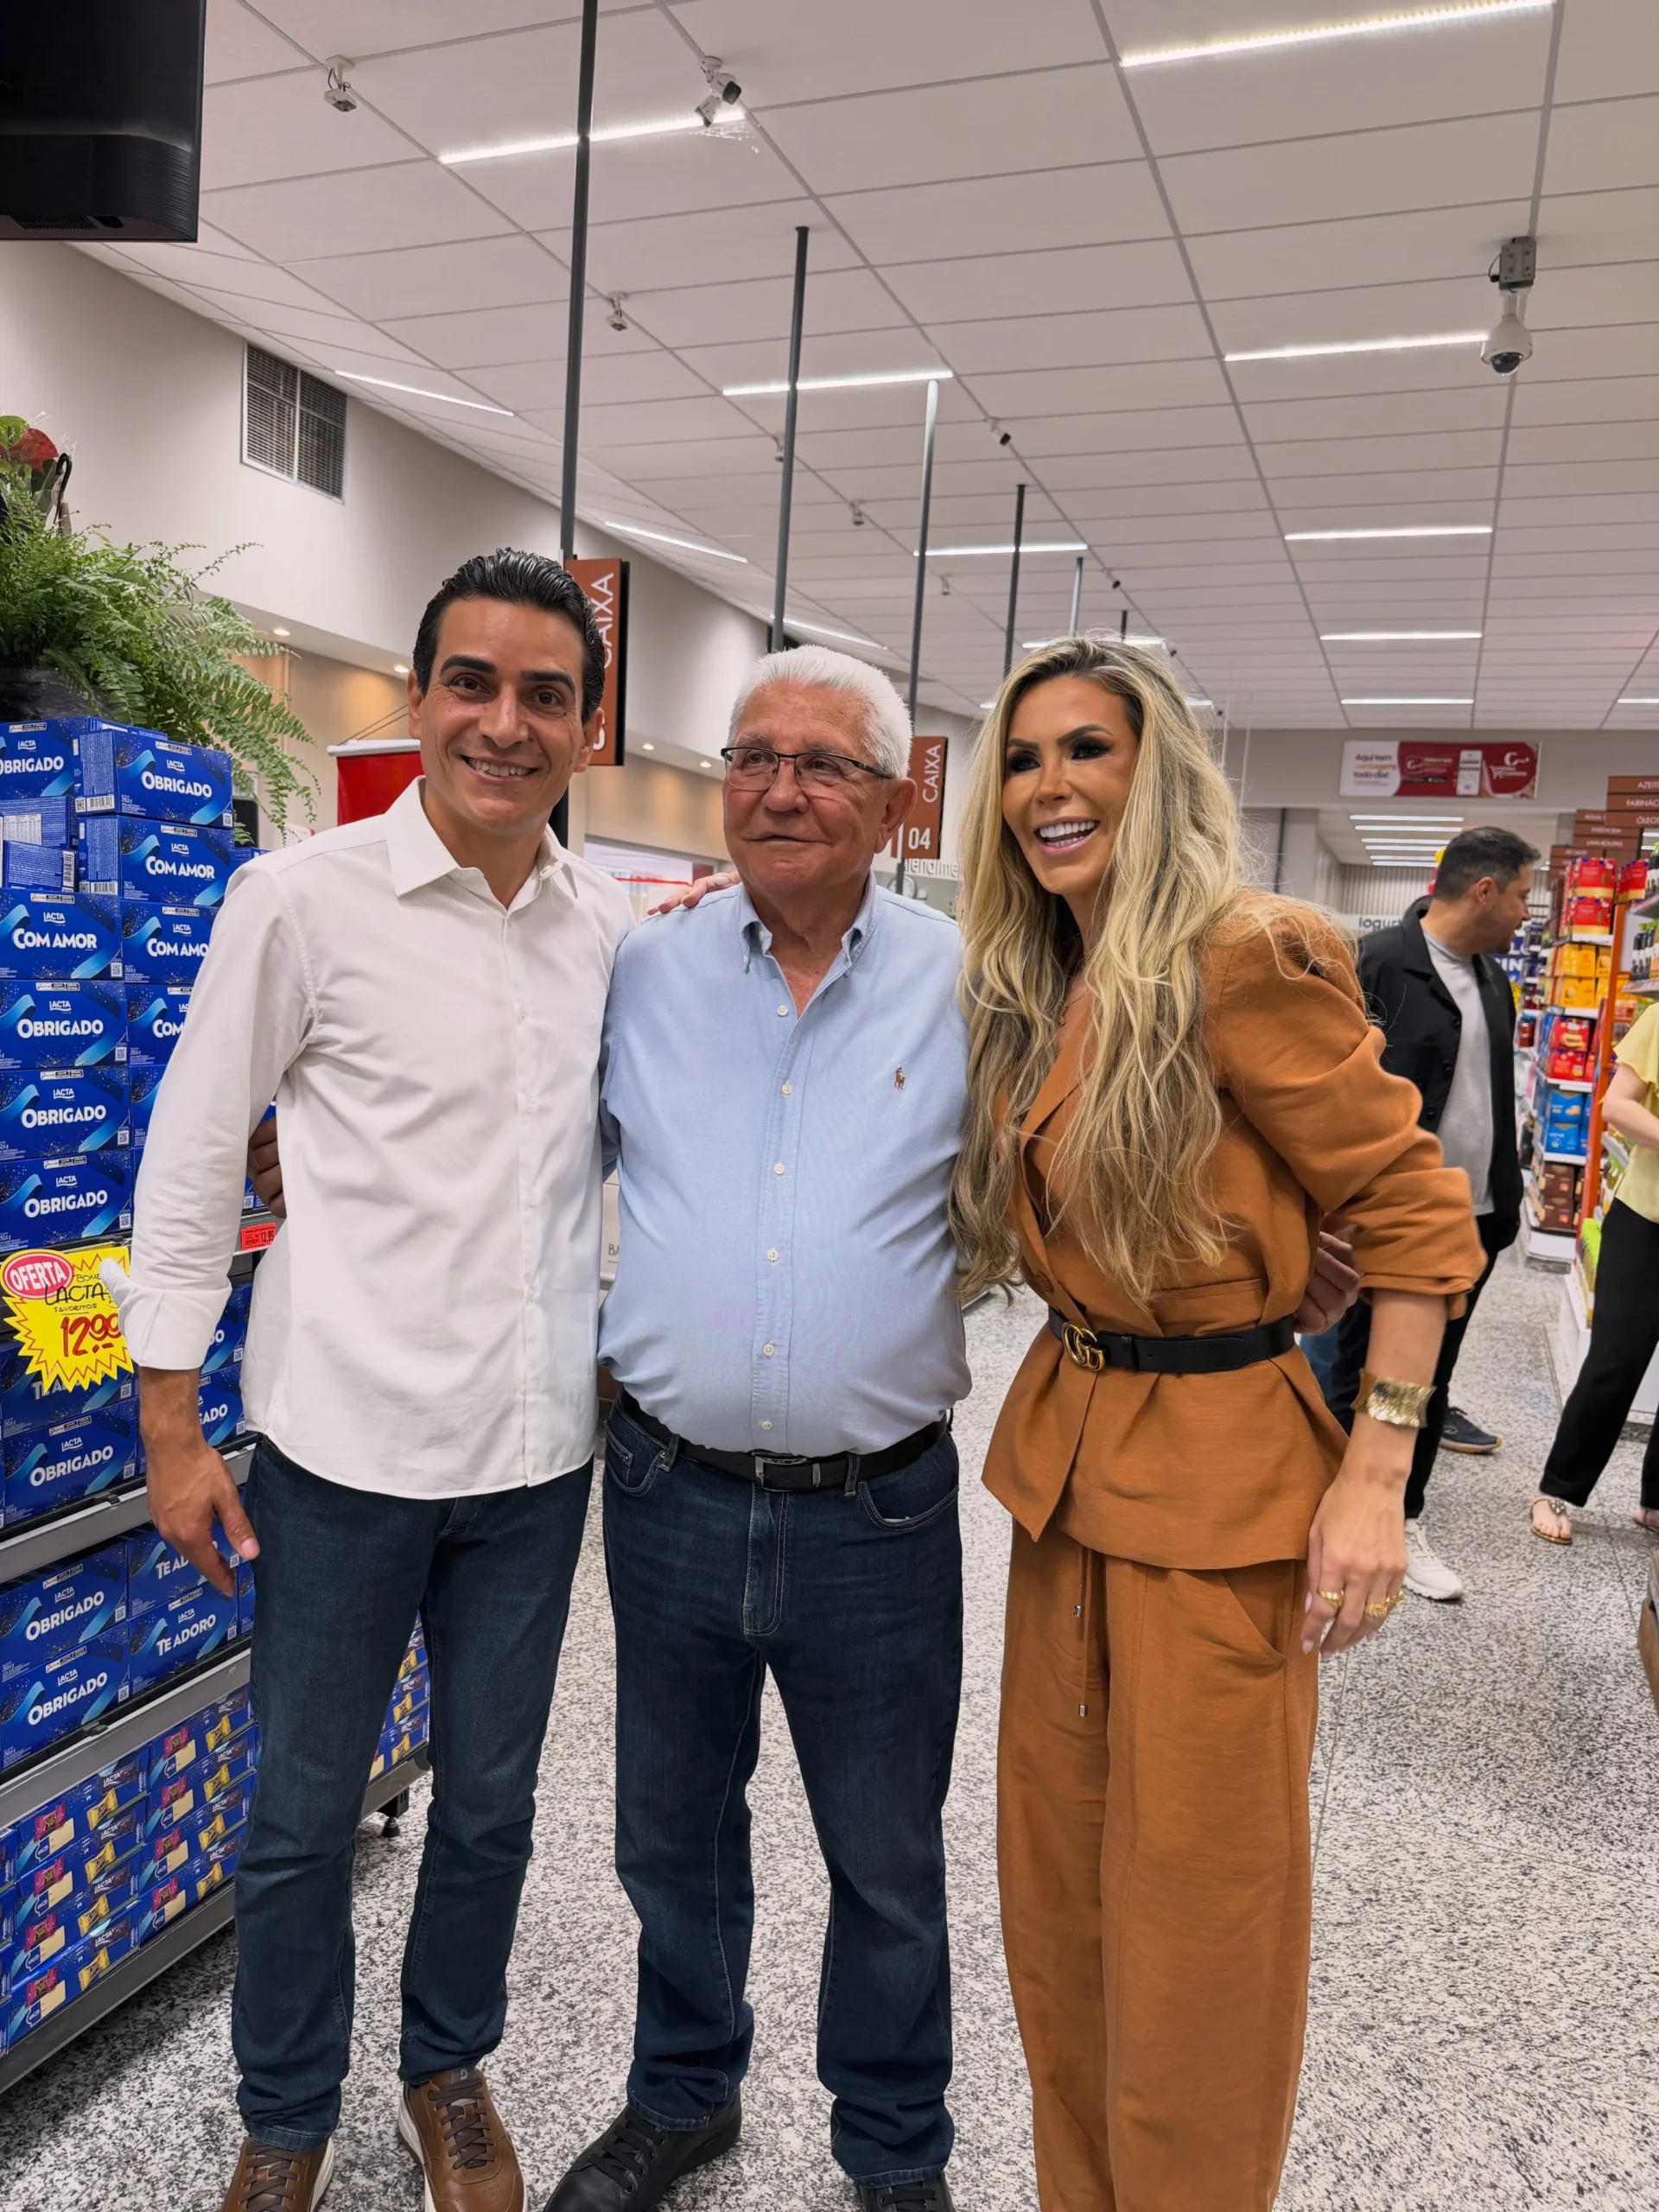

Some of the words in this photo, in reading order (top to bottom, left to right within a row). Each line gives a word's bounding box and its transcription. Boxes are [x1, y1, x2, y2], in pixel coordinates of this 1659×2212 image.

[0, 756, 64, 775] BRIGADO
[922, 744, 942, 803] CAIXA
[142, 771, 213, 798] OBRIGADO
[908, 827, 931, 850] 04
[145, 855, 177, 875] COM
[177, 862, 215, 880] AMOR
[43, 912, 66, 924] LACTA
[13, 928, 51, 950] COM
[52, 933, 98, 949] AMOR
[146, 938, 179, 957] COM
[180, 943, 210, 957] AMO
[49, 1001, 72, 1012] LACTA
[17, 1019, 104, 1039] OBRIGADO
[53, 1088, 75, 1099] LACTA
[22, 1105, 106, 1128] OBRIGADO
[55, 1175, 78, 1188] LACTA
[24, 1190, 108, 1218] OBRIGADO
[10, 1261, 67, 1291] OFERTA
[44, 1283, 110, 1306] LACTA
[61, 1437, 83, 1452] LACTA
[30, 1445, 113, 1487] OBRIGADO
[156, 1560, 171, 1580] TE
[54, 1586, 75, 1604] LACTA
[25, 1591, 105, 1641] OBRIGADO
[178, 1608, 195, 1624] LACTA
[156, 1637, 172, 1656] TE
[173, 1614, 216, 1644] ADORO
[57, 1669, 79, 1687] LACTA
[28, 1672, 108, 1726] OBRIGADO
